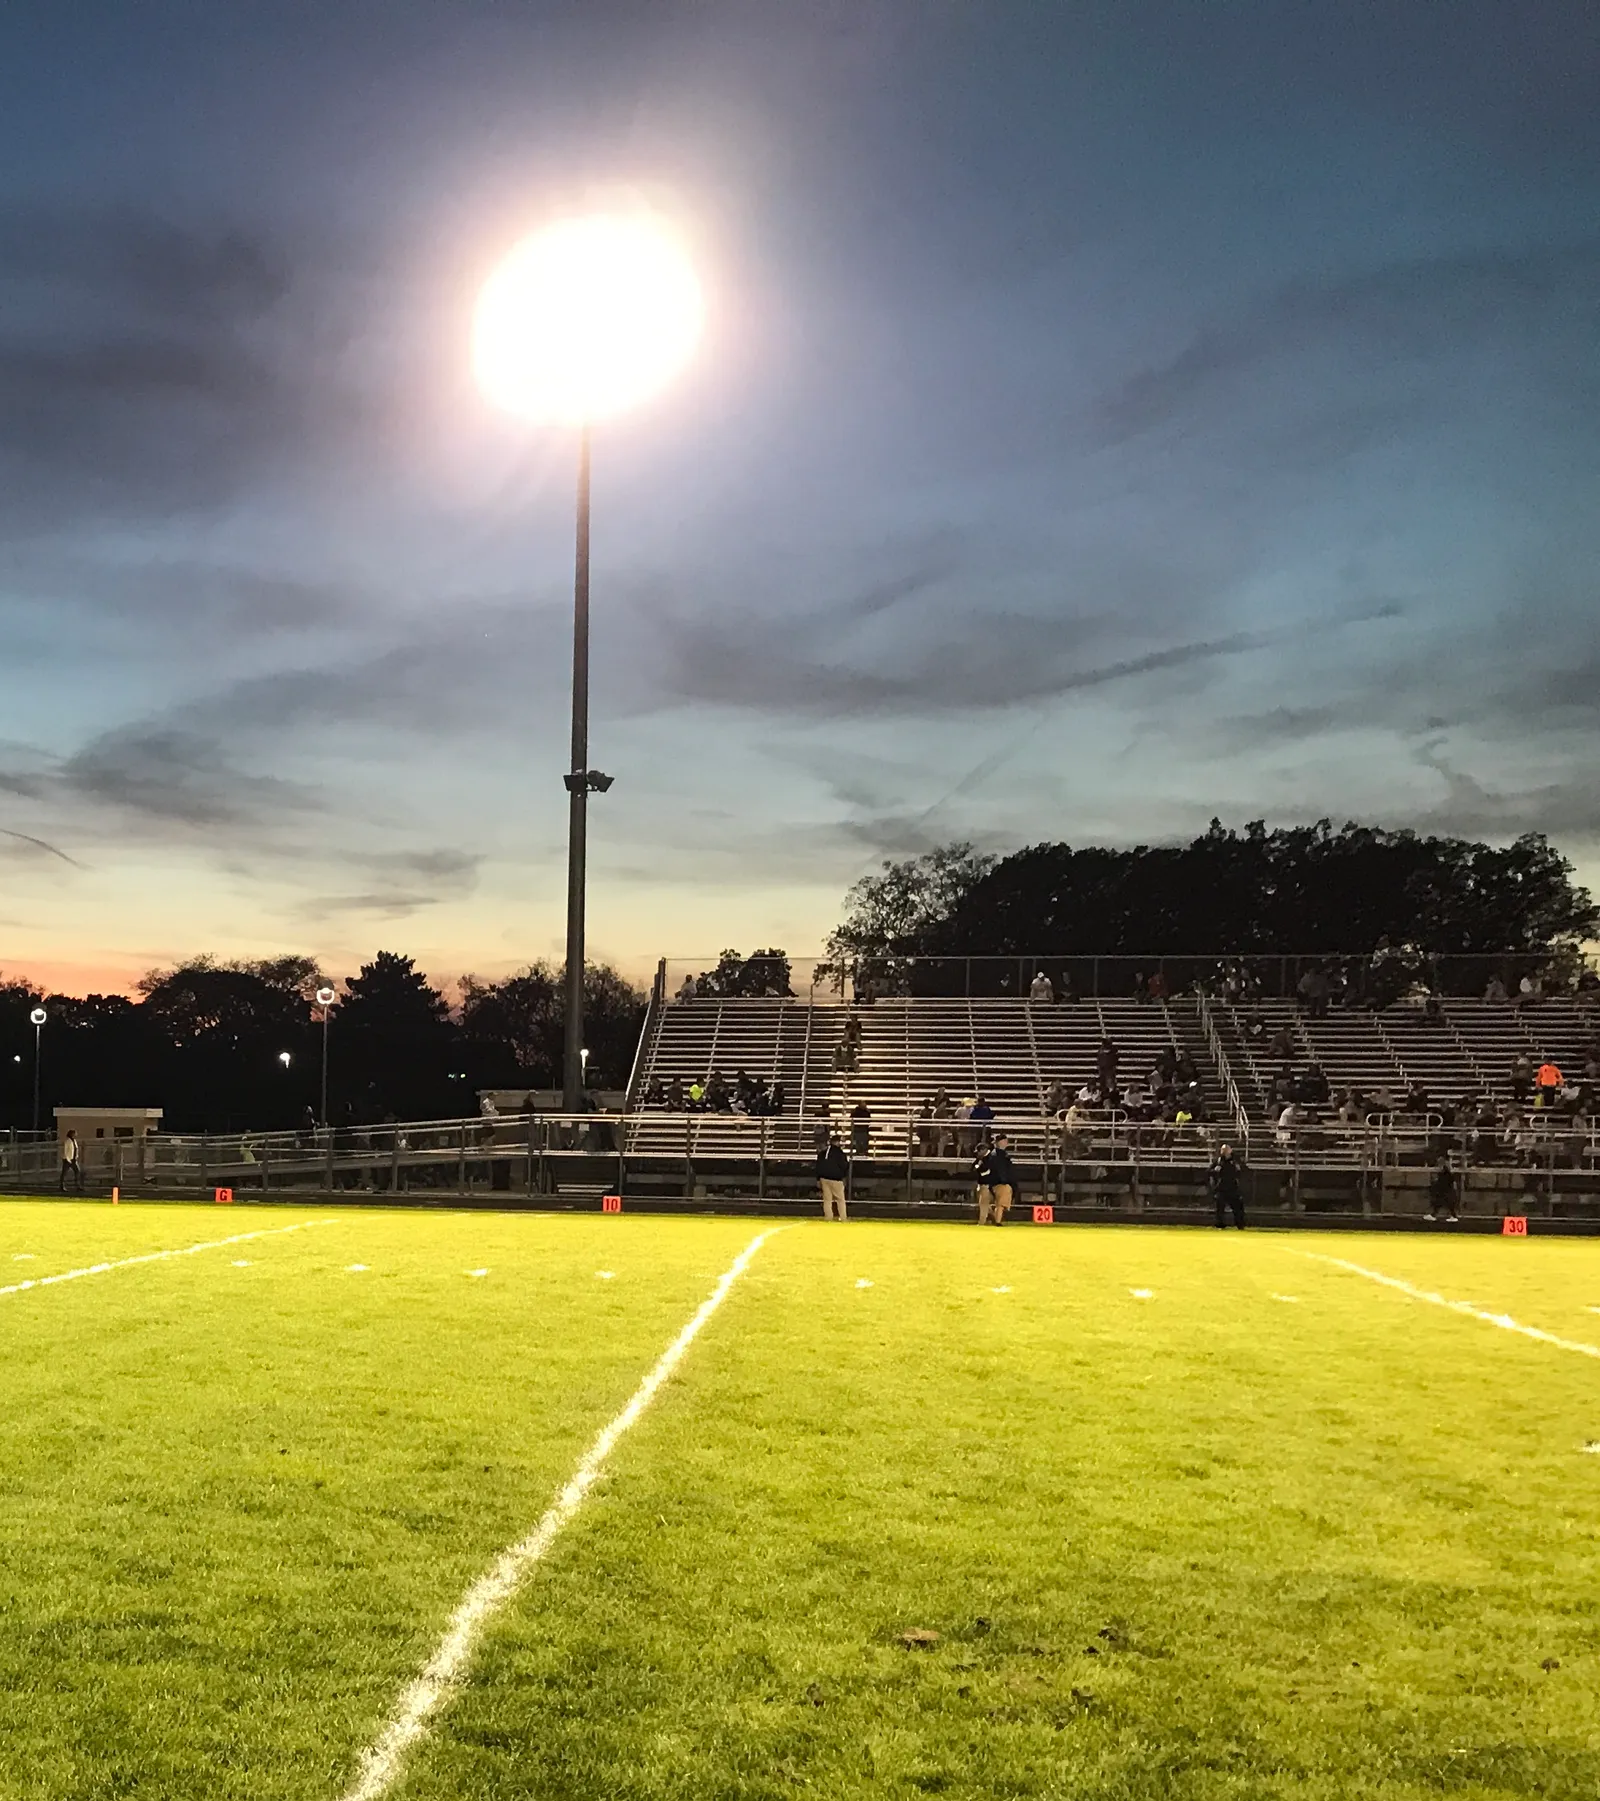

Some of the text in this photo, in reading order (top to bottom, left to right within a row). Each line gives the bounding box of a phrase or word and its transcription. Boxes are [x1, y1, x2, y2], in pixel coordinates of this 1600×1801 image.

[220, 1190, 228, 1201] G
[606, 1198, 618, 1211] 10
[1036, 1208, 1050, 1221] 20
[1509, 1220, 1524, 1233] 30
